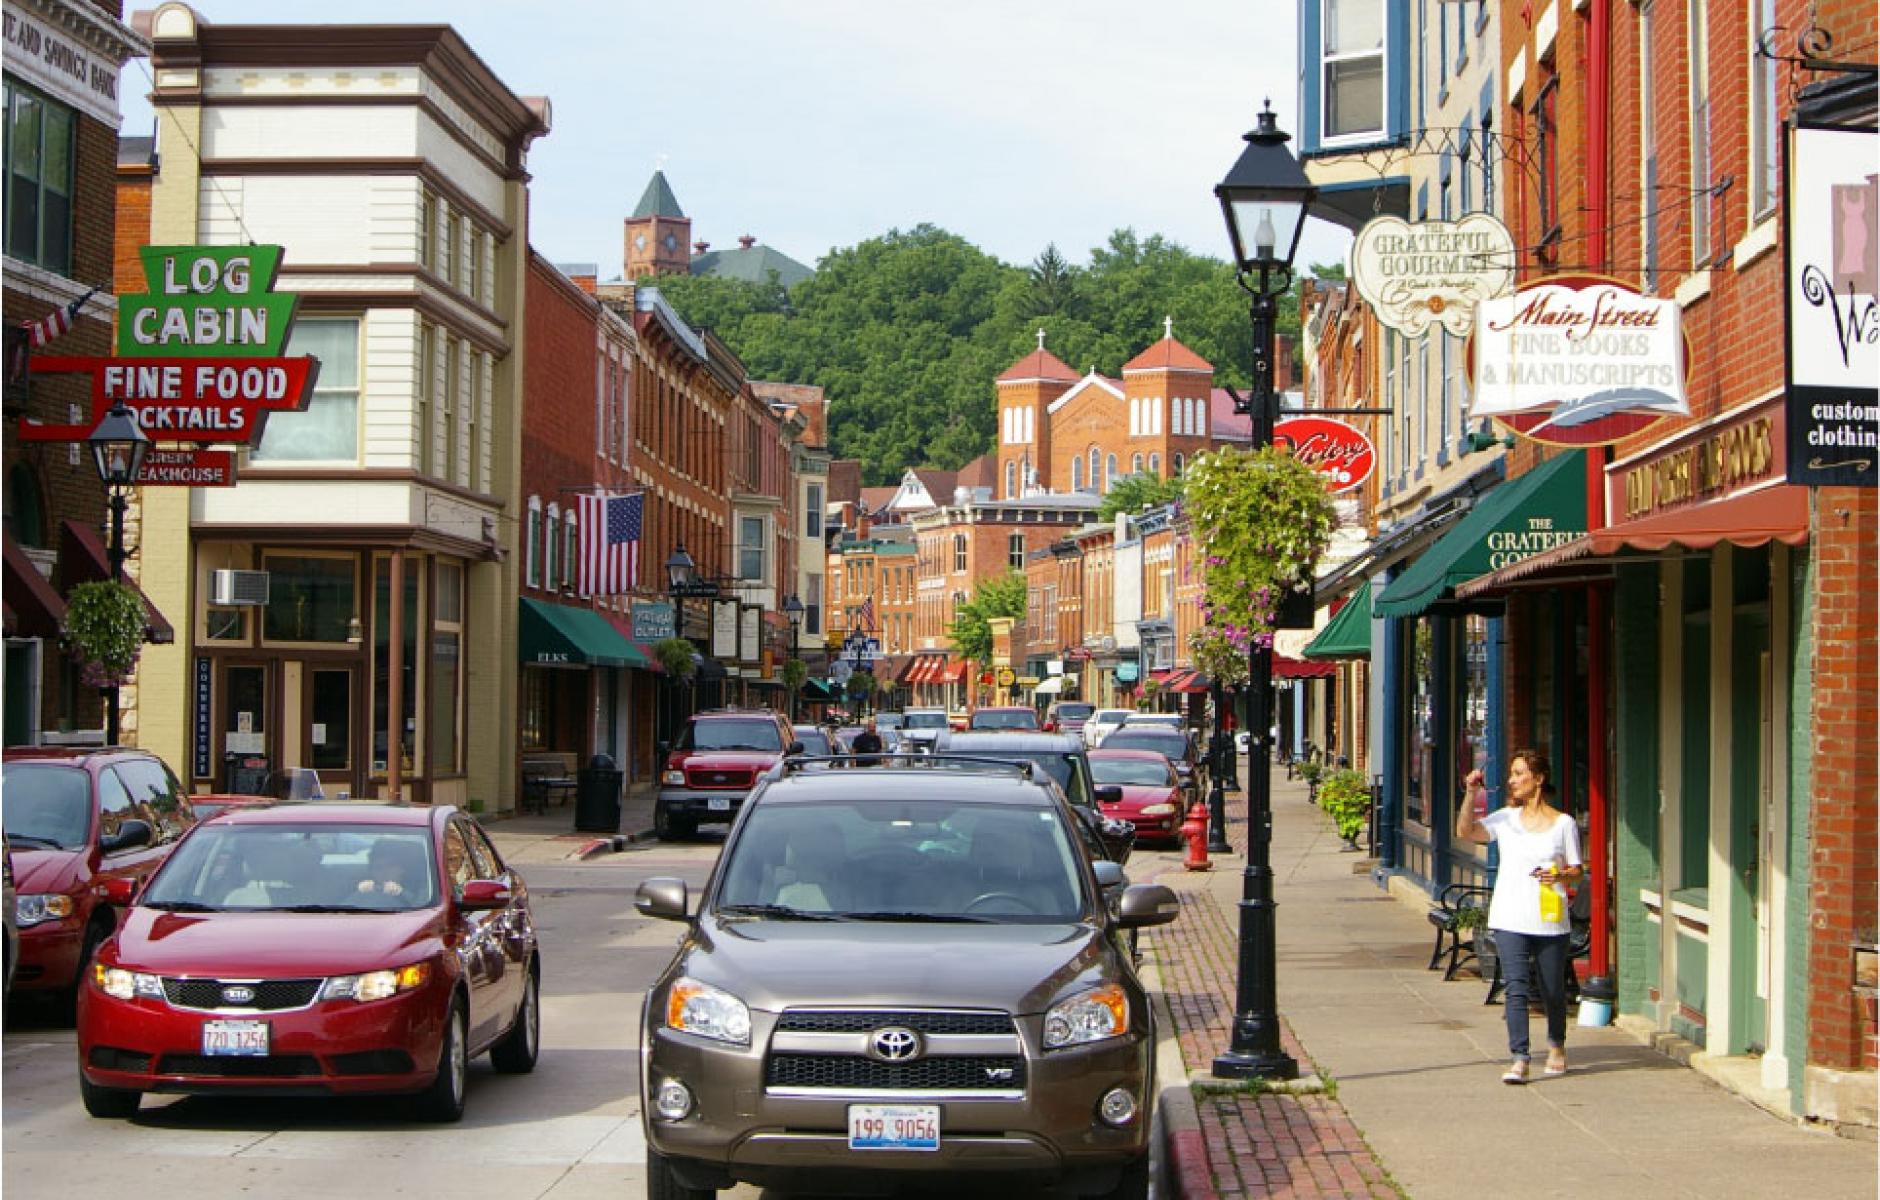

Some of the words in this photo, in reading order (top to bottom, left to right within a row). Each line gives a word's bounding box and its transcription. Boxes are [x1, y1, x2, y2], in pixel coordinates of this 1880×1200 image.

[18, 21, 41, 56] AND
[45, 36, 87, 83] SAVINGS
[92, 63, 116, 101] BANK
[1373, 232, 1496, 254] GRATEFUL
[164, 256, 250, 294] LOG
[1380, 254, 1490, 276] GOURMET
[133, 307, 267, 345] CABIN
[1488, 291, 1590, 332] Main
[1566, 289, 1662, 342] Street
[1507, 333, 1561, 355] FINE
[1569, 333, 1649, 356] BOOKS
[104, 366, 182, 398] FINE
[196, 366, 288, 399] FOOD
[1483, 363, 1498, 385] &
[1506, 362, 1674, 386] MANUSCRIPTS
[126, 405, 244, 430] OCKTAILS
[1811, 400, 1878, 421] custom
[1808, 424, 1878, 449] clothin
[1528, 518, 1552, 530] THE
[537, 652, 568, 662] ELKS
[855, 1119, 884, 1139] 199
[894, 1119, 936, 1139] 9056
